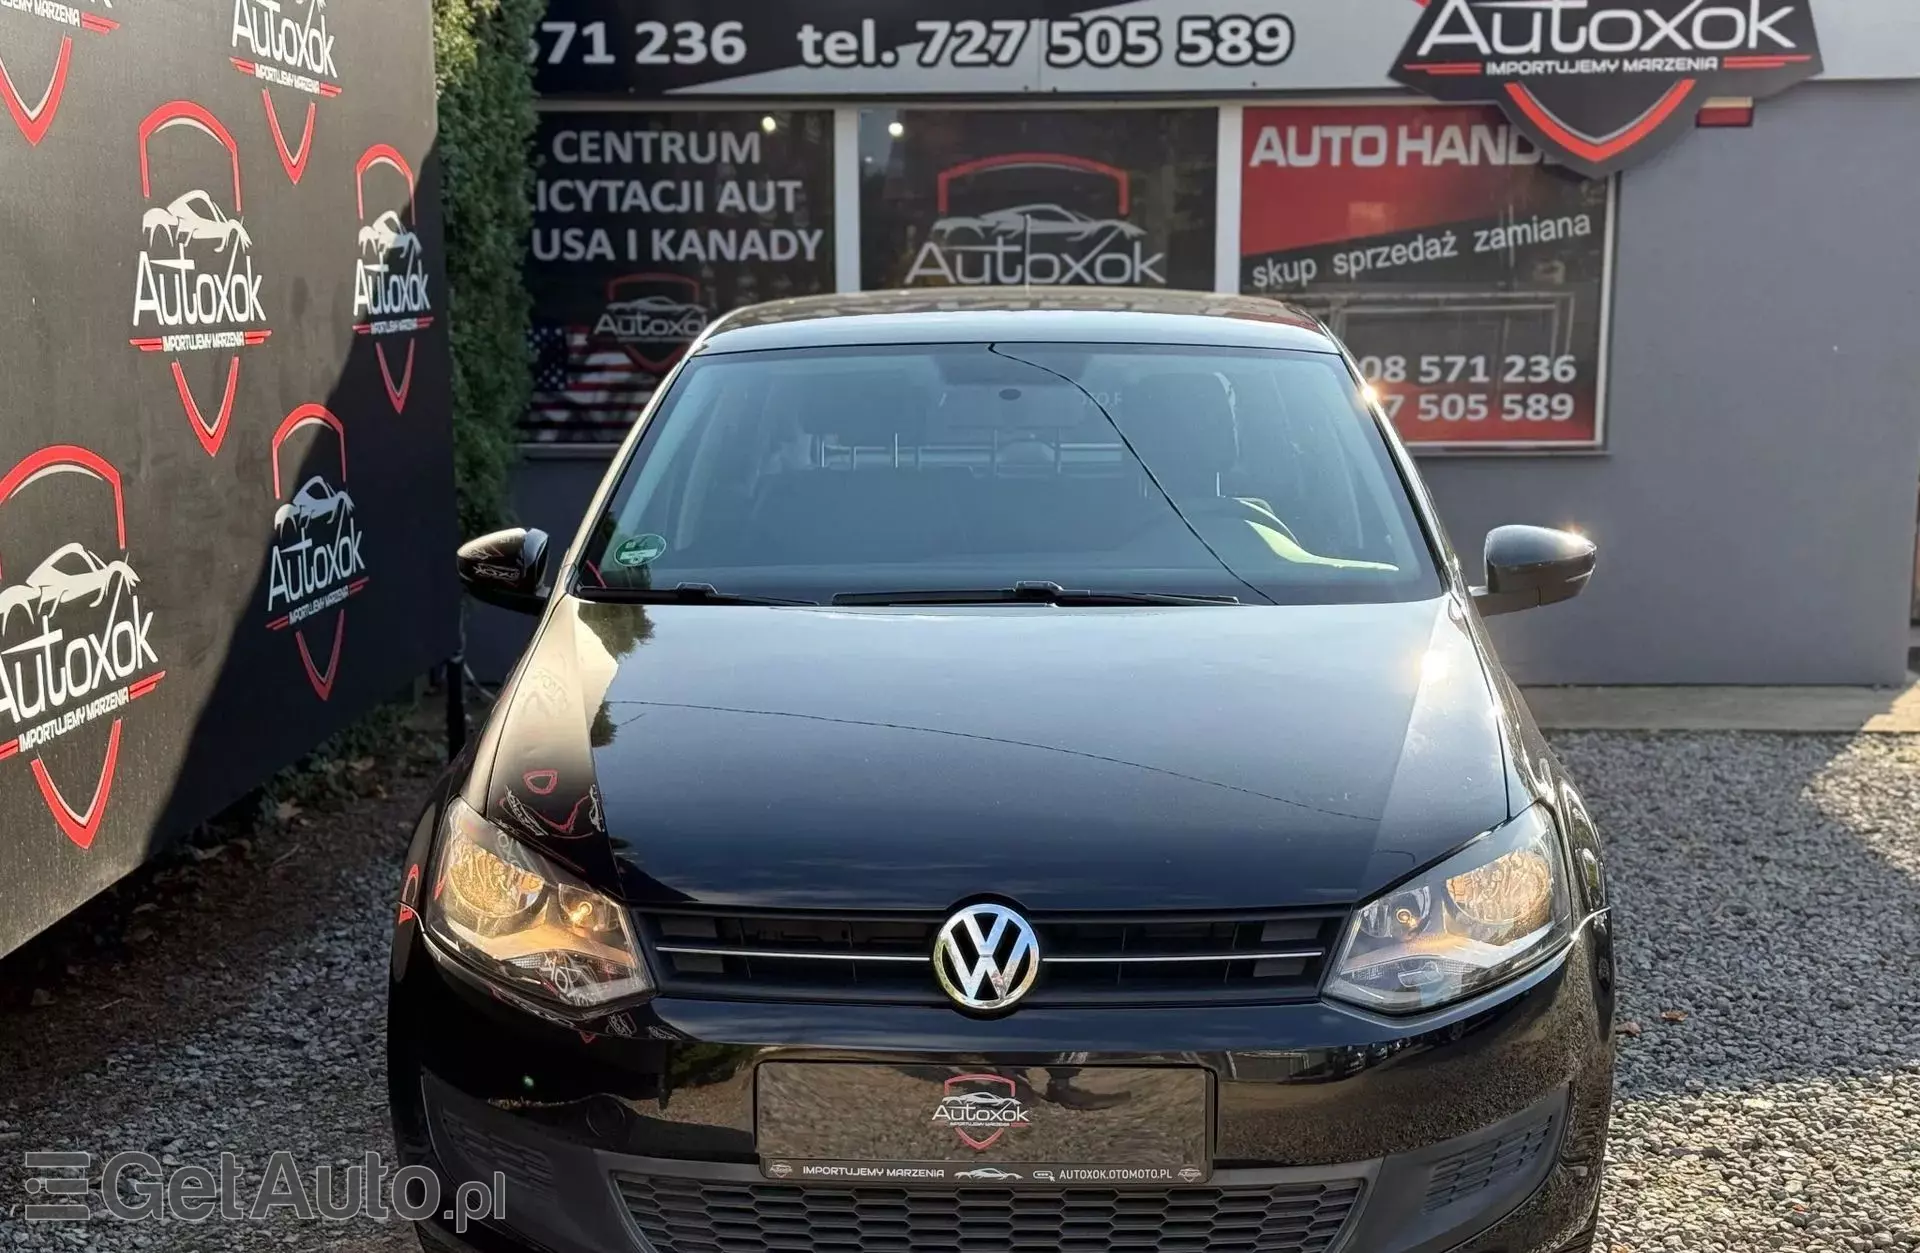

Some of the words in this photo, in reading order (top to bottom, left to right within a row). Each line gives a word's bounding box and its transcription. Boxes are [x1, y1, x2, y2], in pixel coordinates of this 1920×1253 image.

[527, 21, 615, 64] 71
[635, 21, 747, 64] 236
[797, 18, 897, 66] tel.
[916, 18, 1028, 66] 727
[1046, 18, 1161, 67] 505
[1176, 14, 1295, 65] 589
[1416, 0, 1796, 56] Autoxok
[1486, 59, 1620, 76] IMPORTUJEMY
[1622, 57, 1718, 72] MARZENIA
[552, 131, 760, 164] CENTRUM
[1249, 125, 1387, 168] AUTO
[1396, 124, 1562, 167] HAND
[530, 180, 704, 213] ICYTACJI
[716, 180, 803, 213] AUT
[531, 229, 616, 261] USA
[627, 229, 638, 261] I
[651, 229, 824, 261] KANADY
[1252, 257, 1318, 289] skup
[1333, 231, 1459, 278] sprzedaż
[1473, 213, 1592, 253] zamiana
[1418, 354, 1490, 384] 571
[1503, 354, 1577, 384] 236
[1416, 393, 1488, 422] 505
[1501, 393, 1575, 422] 589
[18, 706, 86, 753] IMPORTUJEMY
[86, 686, 130, 721] MARZENIA
[931, 1103, 1030, 1122] Autoxok
[802, 1165, 884, 1177] IMPORTUJEMY
[886, 1168, 945, 1178] MARZENIA
[1059, 1169, 1173, 1180] AUTOXOK.OTOMOTO.PL
